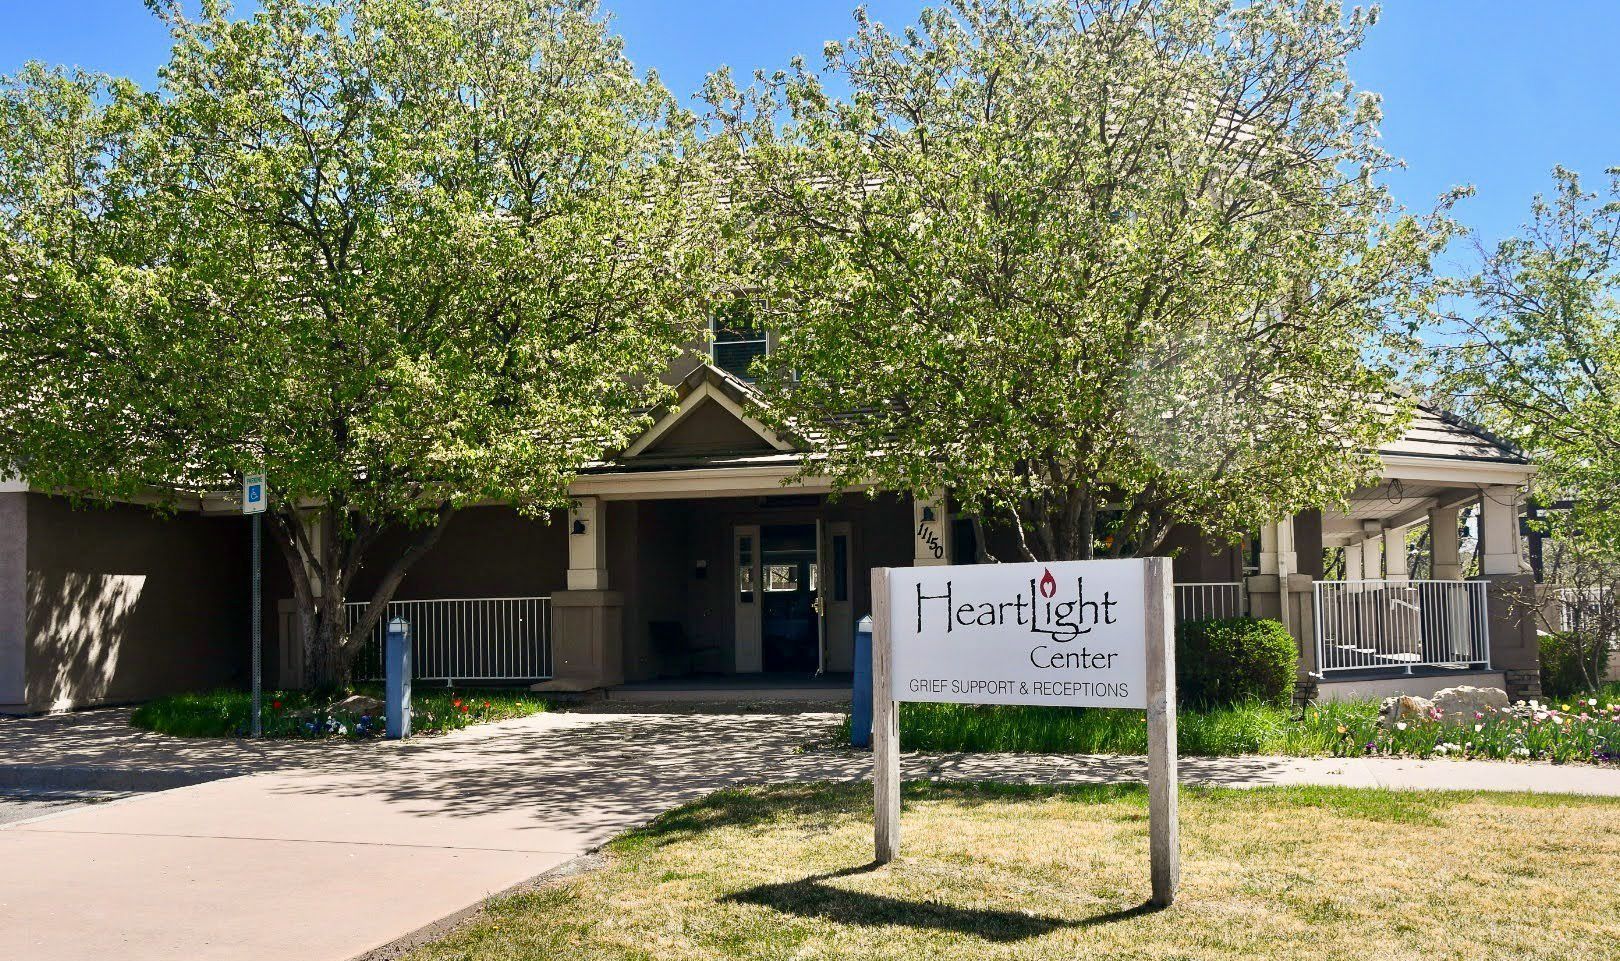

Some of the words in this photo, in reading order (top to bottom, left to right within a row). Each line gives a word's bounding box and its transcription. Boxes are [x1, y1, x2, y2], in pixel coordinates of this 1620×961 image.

[917, 522, 944, 559] 11150
[915, 576, 1118, 643] HeartLight
[1030, 645, 1119, 669] Center
[909, 679, 948, 693] GRIEF
[951, 680, 1016, 695] SUPPORT
[1019, 682, 1029, 696] &
[1033, 681, 1129, 698] RECEPTIONS
